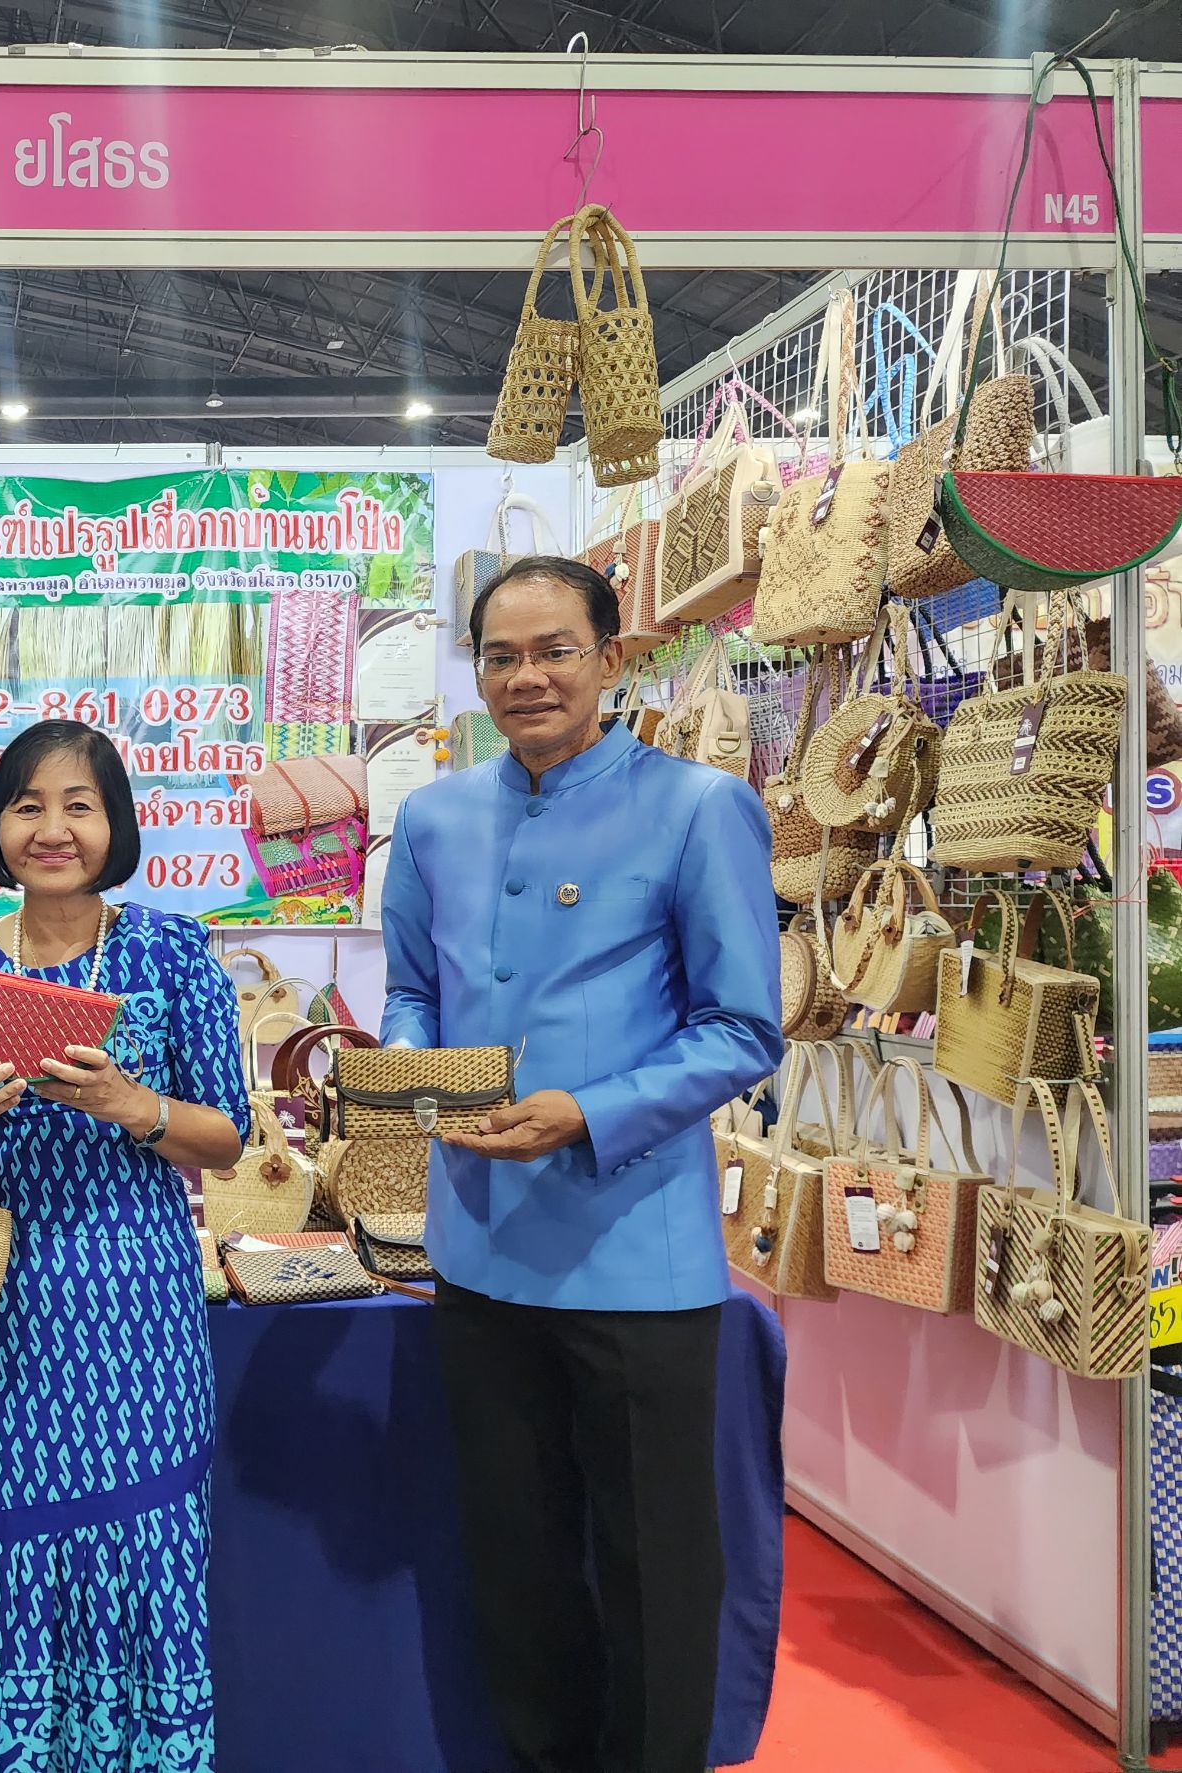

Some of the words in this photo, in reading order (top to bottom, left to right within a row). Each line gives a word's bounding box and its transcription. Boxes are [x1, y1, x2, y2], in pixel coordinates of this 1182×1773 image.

[14, 111, 170, 190] ยโสธร
[1044, 193, 1100, 226] N45
[78, 575, 187, 597] อำเภอทรายมูล
[303, 571, 354, 591] 35170
[142, 687, 251, 723] 0873
[146, 853, 240, 889] 0873
